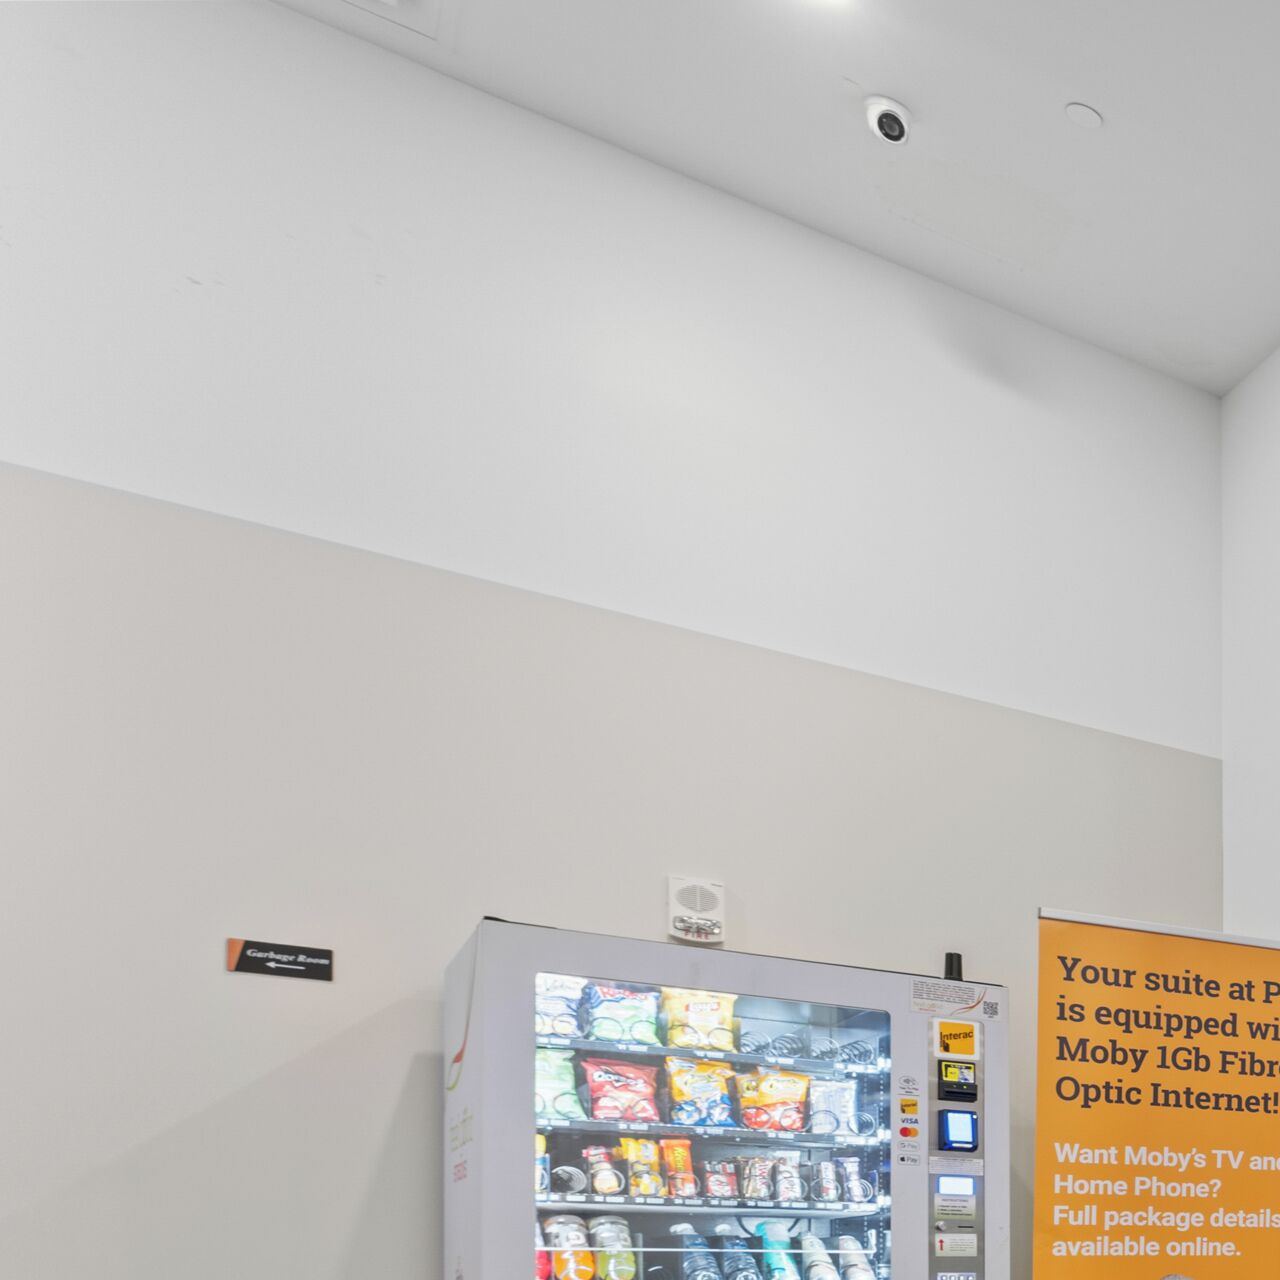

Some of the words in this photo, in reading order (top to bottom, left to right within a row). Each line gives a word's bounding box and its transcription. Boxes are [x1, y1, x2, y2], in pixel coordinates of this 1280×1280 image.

[683, 927, 711, 941] FIRE
[246, 948, 295, 962] Garbage
[297, 954, 331, 965] Room
[1057, 955, 1137, 989] Your
[1144, 969, 1221, 999] suite
[1228, 978, 1256, 1004] at
[1056, 995, 1085, 1023] is
[1094, 1004, 1239, 1040] equipped
[1056, 1036, 1149, 1073] Moby
[1156, 1045, 1211, 1073] 1Gb
[1055, 1076, 1142, 1109] Optic
[1150, 1082, 1280, 1114] Internet!
[900, 1117, 919, 1125] VISA
[1054, 1142, 1121, 1166] Want
[1124, 1147, 1207, 1172] Moby's
[1211, 1149, 1244, 1169] TV
[1053, 1174, 1128, 1196] Home
[1134, 1177, 1222, 1198] Phone?
[1052, 1205, 1097, 1226] Full
[1104, 1209, 1204, 1232] package
[1052, 1235, 1160, 1257] available
[1166, 1237, 1241, 1257] online.
